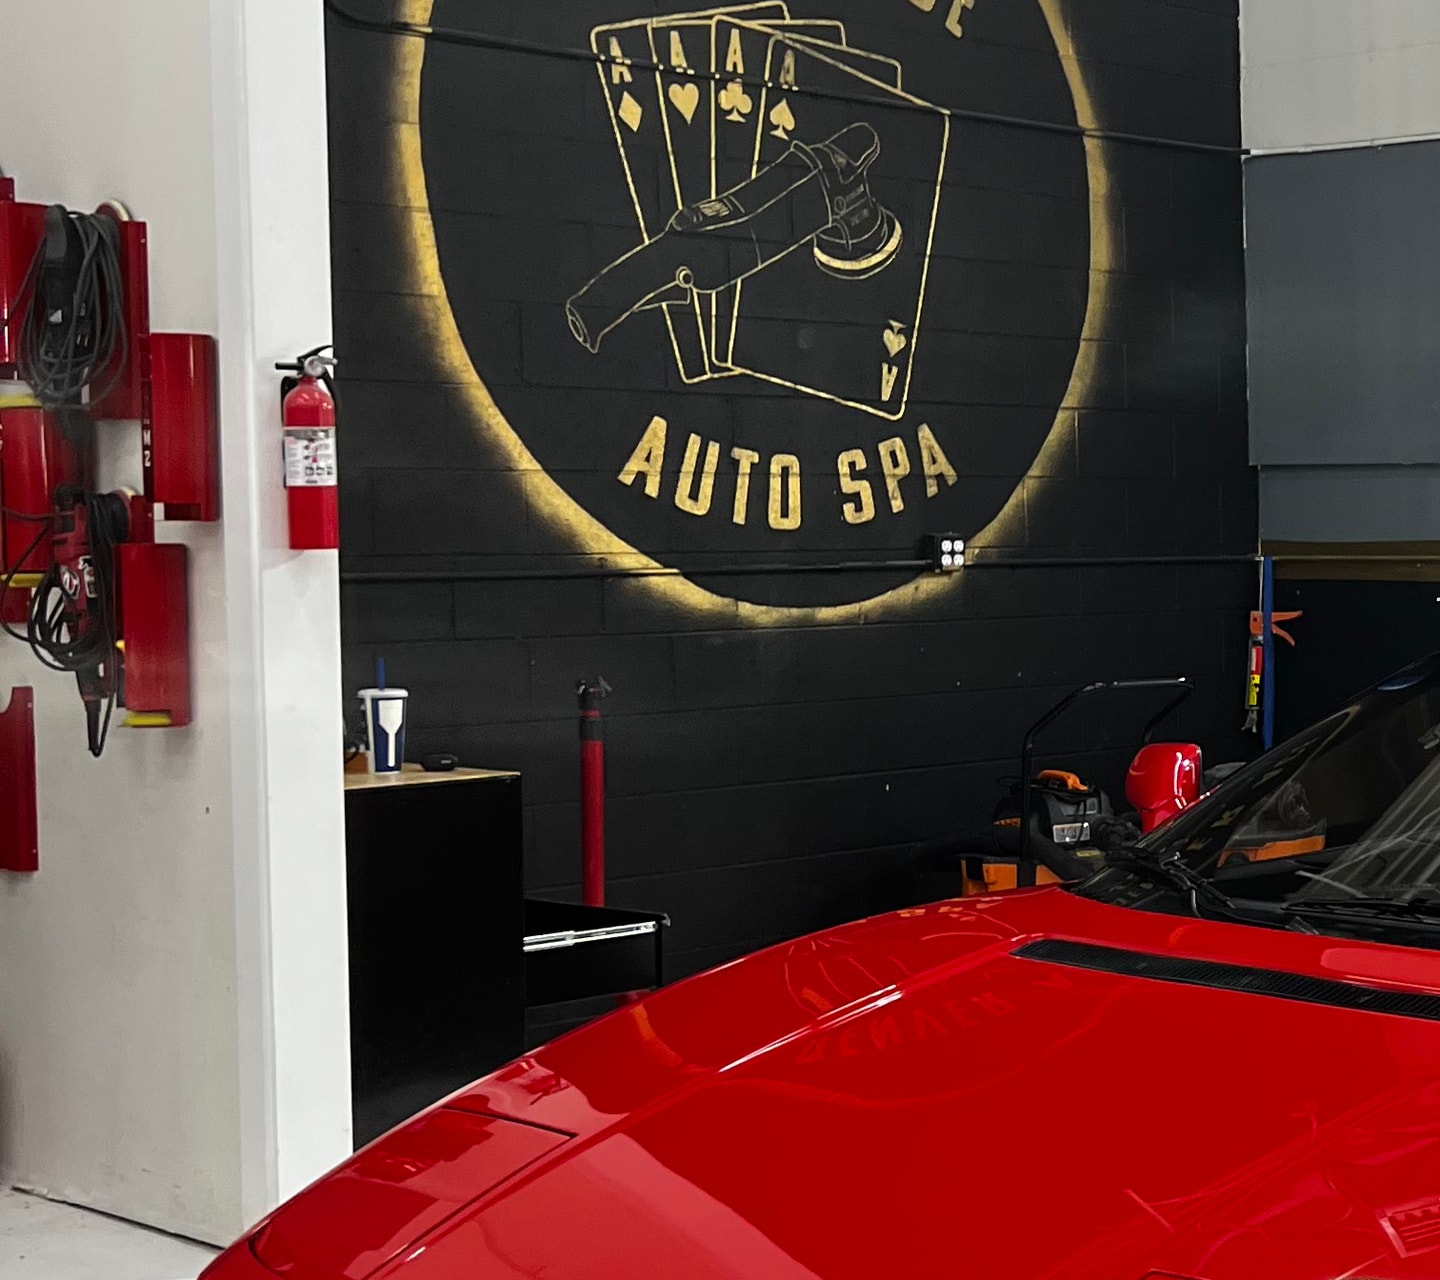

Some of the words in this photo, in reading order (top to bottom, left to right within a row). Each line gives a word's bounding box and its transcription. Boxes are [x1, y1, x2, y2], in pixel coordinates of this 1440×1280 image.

[608, 35, 633, 86] A
[669, 29, 695, 76] A
[725, 27, 745, 75] A
[779, 48, 800, 92] A
[616, 414, 802, 531] AUTO
[837, 422, 959, 525] SPA
